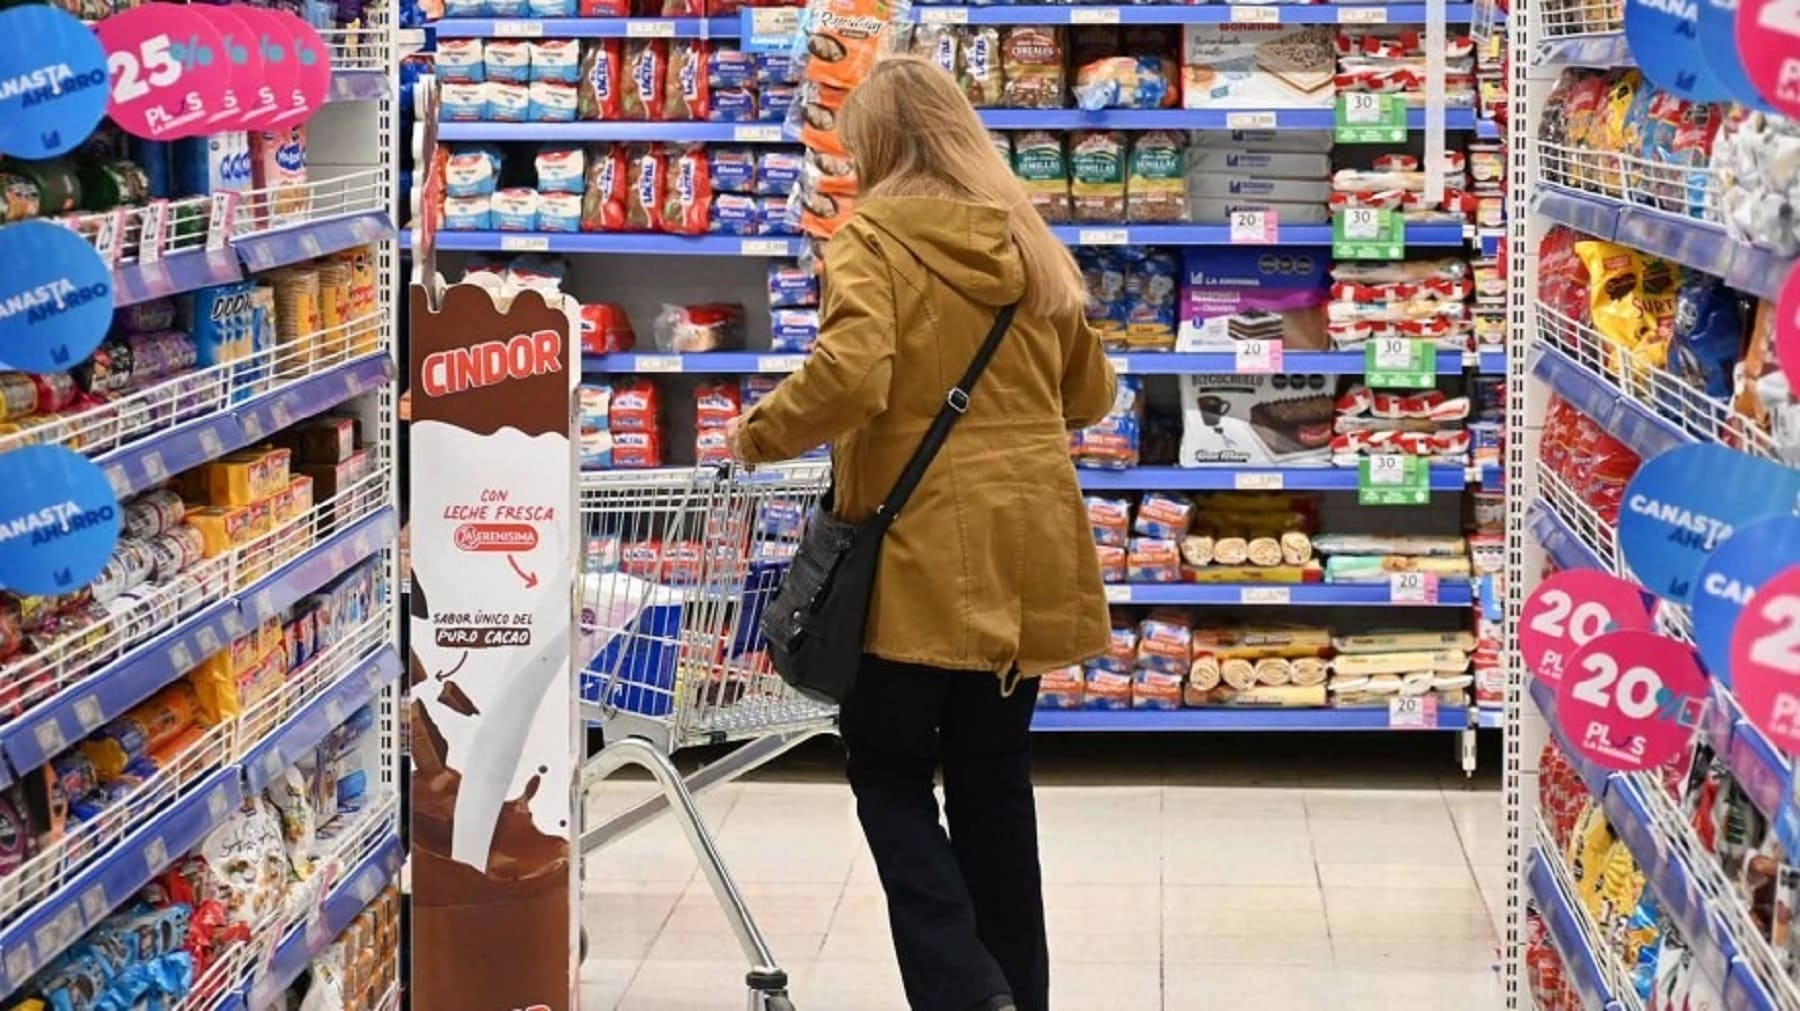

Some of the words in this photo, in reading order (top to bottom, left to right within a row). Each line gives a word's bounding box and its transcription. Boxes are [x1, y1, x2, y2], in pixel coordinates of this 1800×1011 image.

[107, 34, 213, 104] 25%
[1354, 95, 1372, 109] 30
[1239, 214, 1256, 226] 20
[1353, 210, 1370, 223] 30
[1632, 297, 1673, 319] SURT
[1243, 343, 1261, 355] 20
[1384, 340, 1401, 353] 30
[422, 330, 562, 397] CINDOR
[1377, 456, 1395, 468] 30
[481, 490, 509, 502] CON
[443, 505, 488, 520] LECHE
[494, 505, 555, 521] FRESCA
[1630, 494, 1733, 550] CANASTA
[1400, 574, 1418, 588] 20
[433, 612, 472, 625] SABOR
[475, 609, 510, 625] ÚNICO
[512, 613, 533, 625] DEL
[437, 630, 479, 643] PURO
[484, 630, 529, 644] CACAO
[1398, 699, 1417, 713] 20
